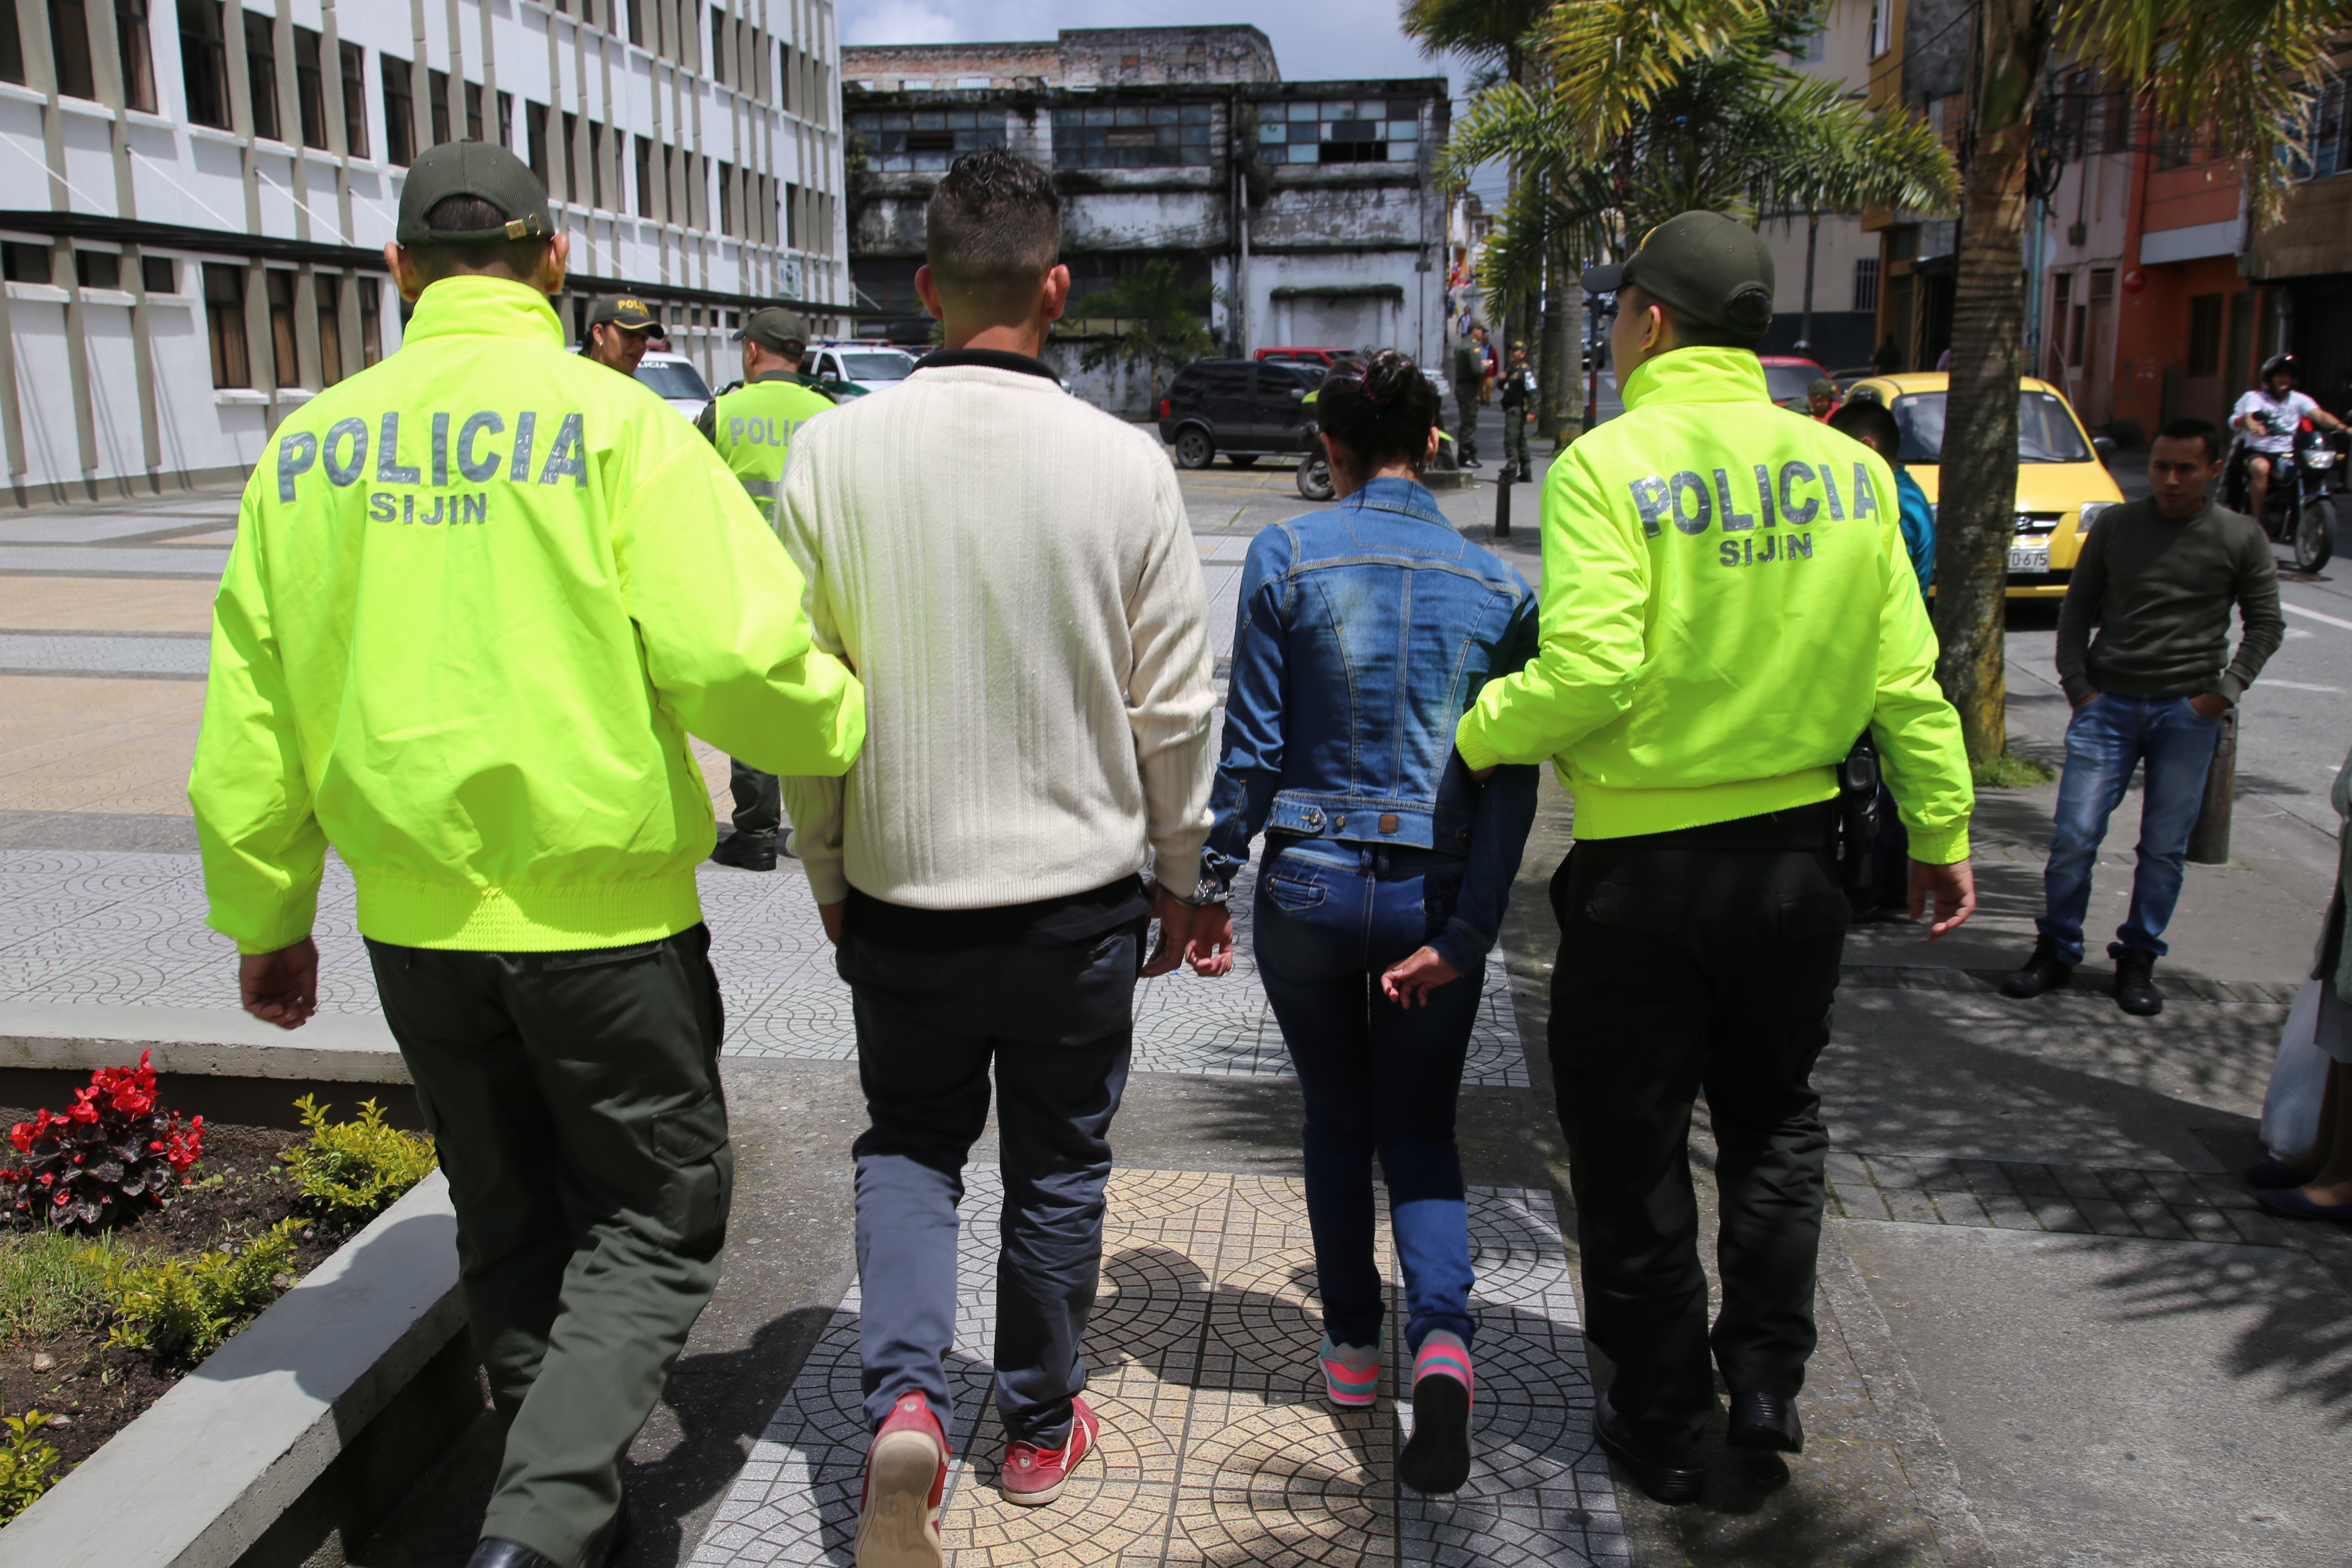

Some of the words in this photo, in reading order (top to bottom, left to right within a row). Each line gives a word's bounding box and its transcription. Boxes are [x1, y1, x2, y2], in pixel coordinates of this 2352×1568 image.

[279, 411, 587, 504] POLICIA
[369, 493, 487, 525] SIJIN
[1628, 461, 1879, 538] POLICIA
[1720, 533, 1813, 566] SIJIN
